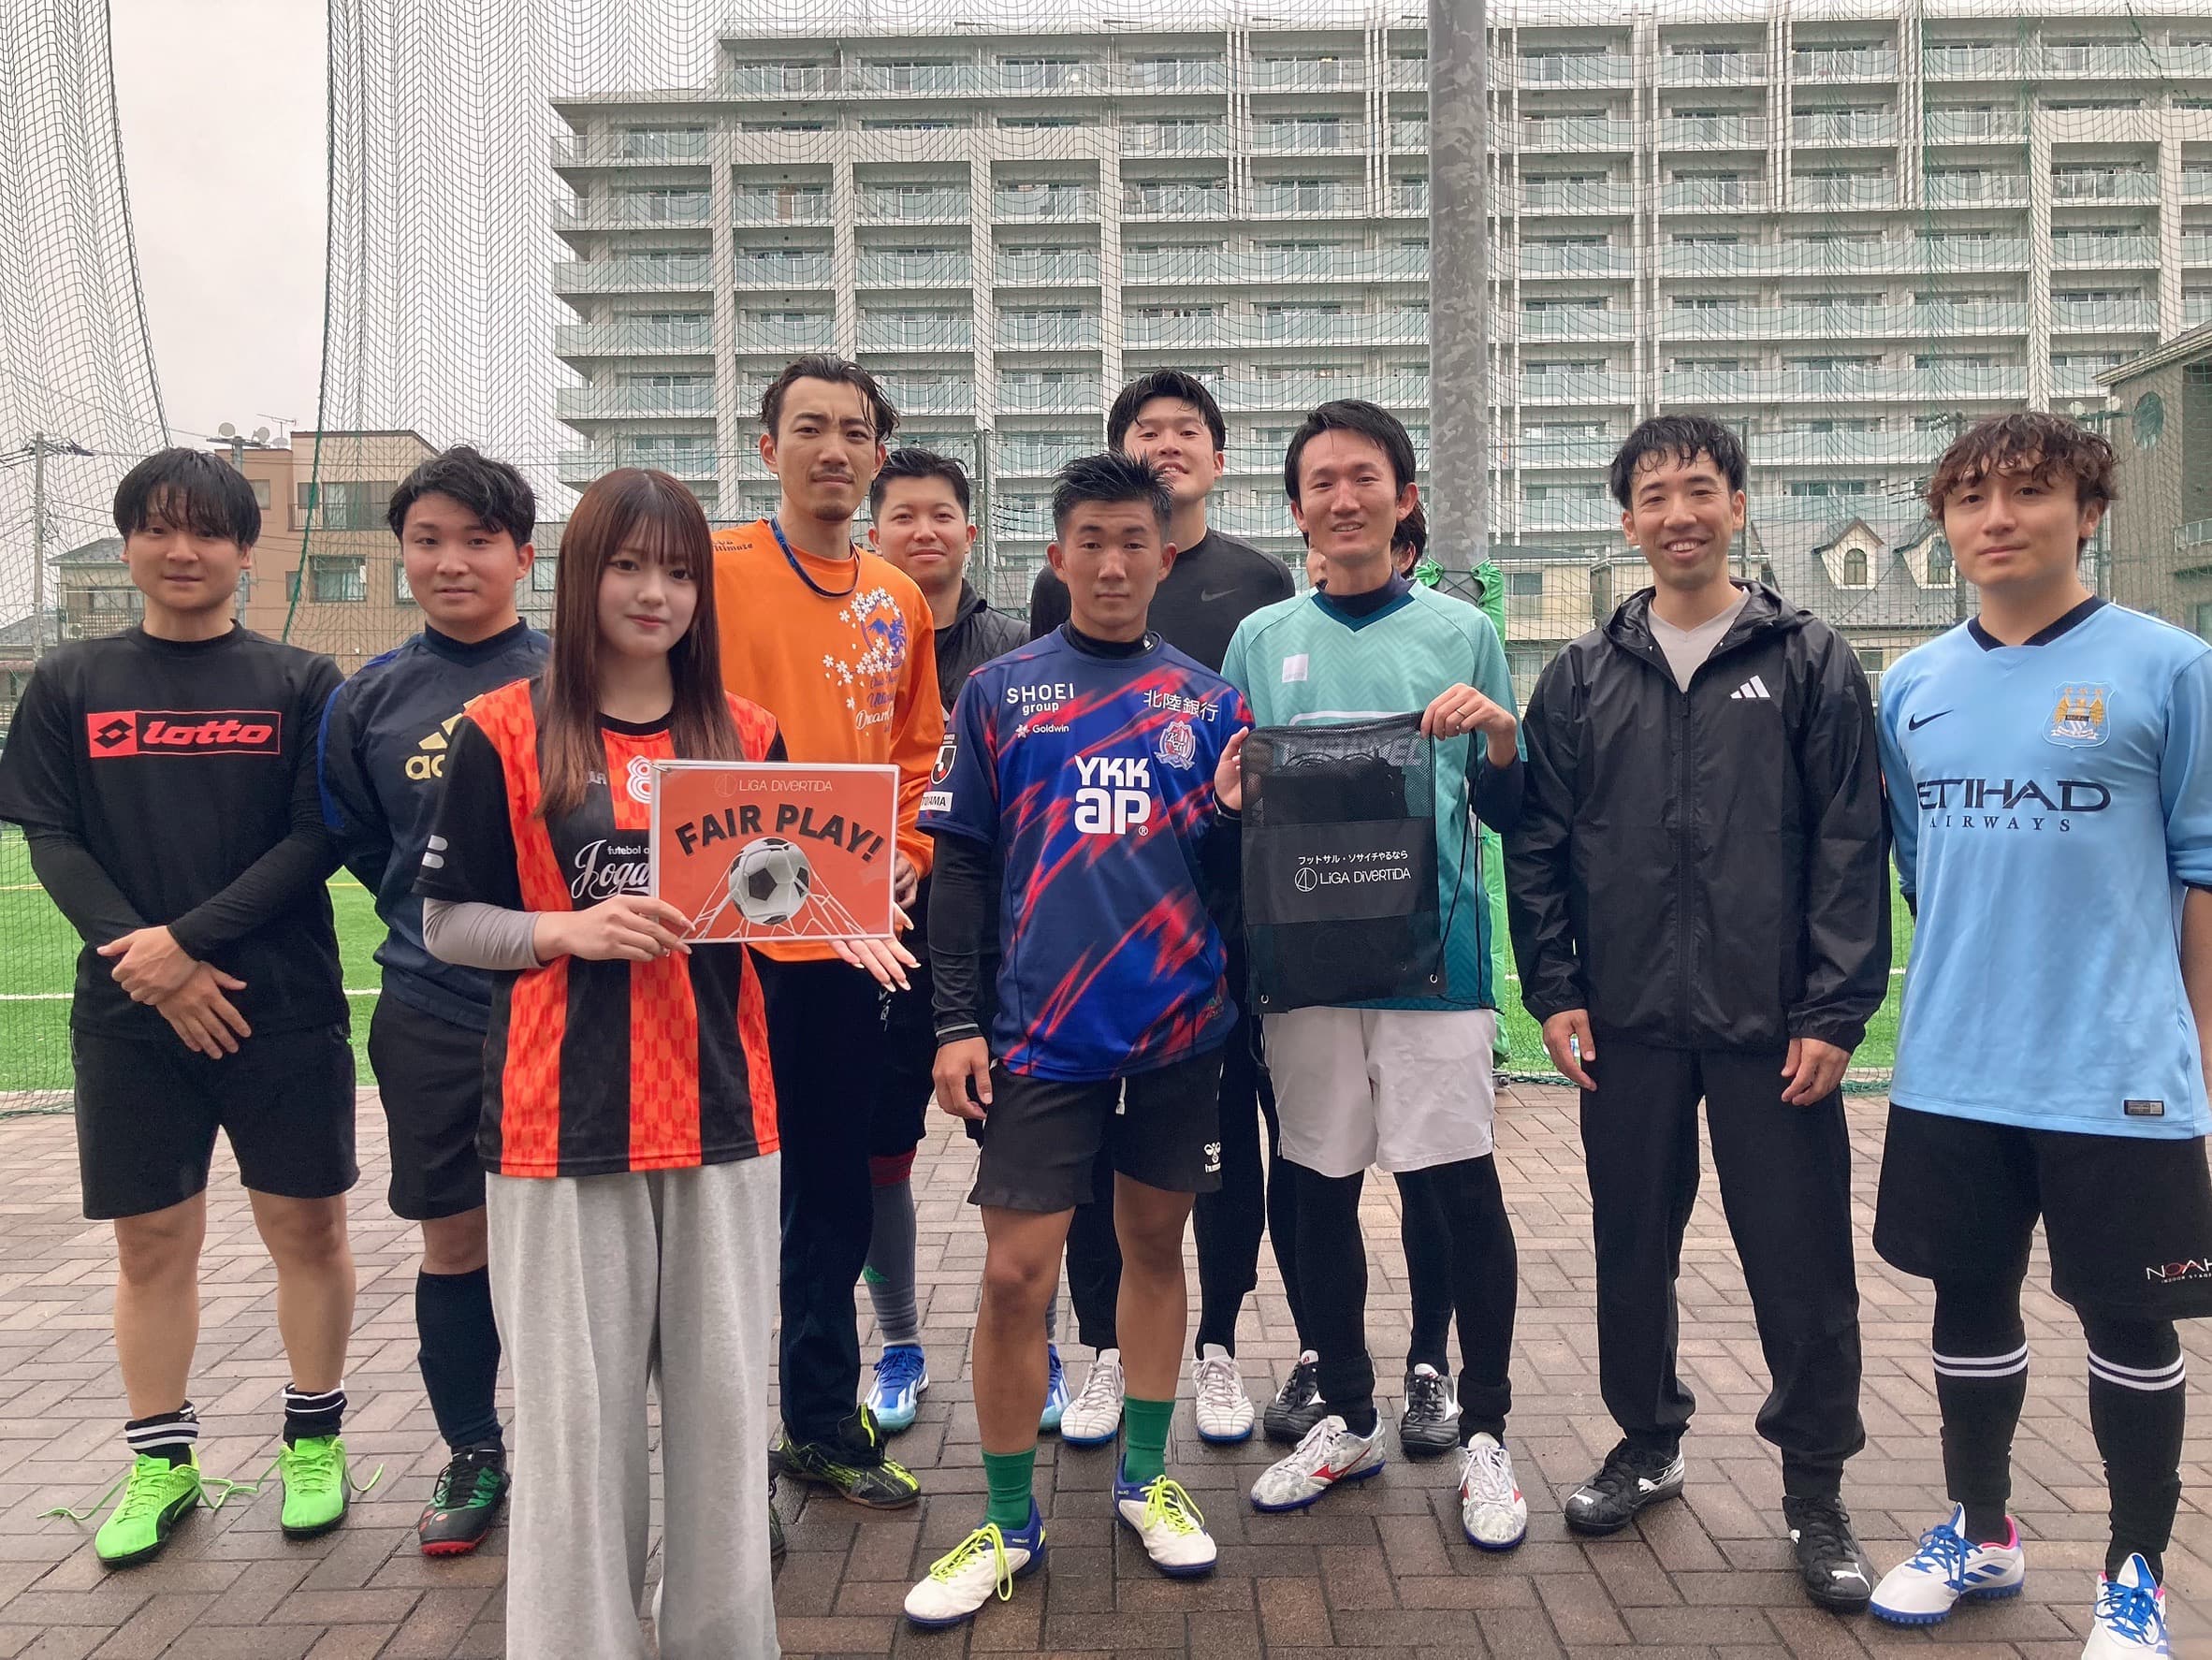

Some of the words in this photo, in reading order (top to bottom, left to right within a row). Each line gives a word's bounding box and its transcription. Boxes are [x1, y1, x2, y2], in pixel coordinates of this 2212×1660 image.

[1006, 682, 1075, 705] SHOEI
[1022, 702, 1060, 717] group
[1142, 689, 1220, 723] 北陸銀行
[142, 720, 273, 746] lotto
[1032, 723, 1070, 734] Goldwin
[1074, 754, 1150, 788] YKK
[1916, 778, 2112, 812] ETIHAD
[675, 804, 764, 856] FAIR
[775, 803, 884, 862] PLAY!
[1929, 815, 2071, 832] AIRWAYS
[607, 845, 641, 855] futebol
